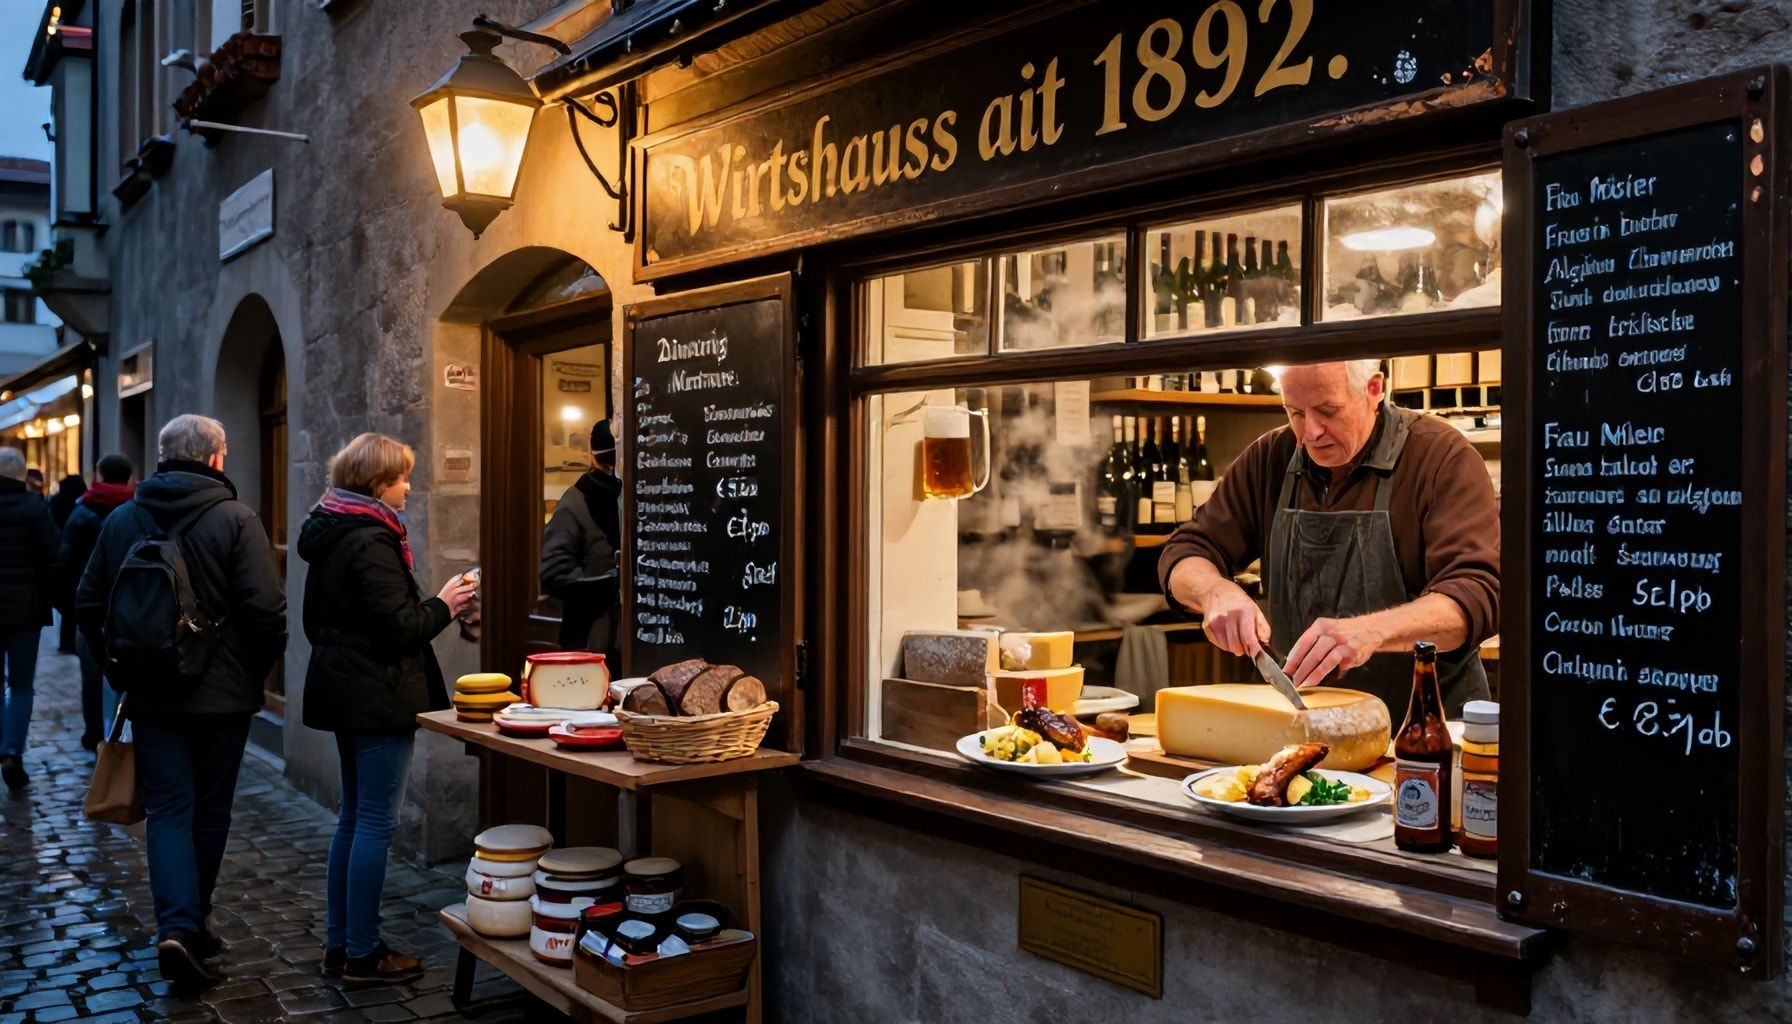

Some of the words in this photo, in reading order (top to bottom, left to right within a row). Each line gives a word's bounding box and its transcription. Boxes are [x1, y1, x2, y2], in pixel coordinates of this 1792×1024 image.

[669, 110, 958, 238] Wirtshauss
[978, 56, 1065, 161] ait
[1093, 0, 1348, 136] 1892.
